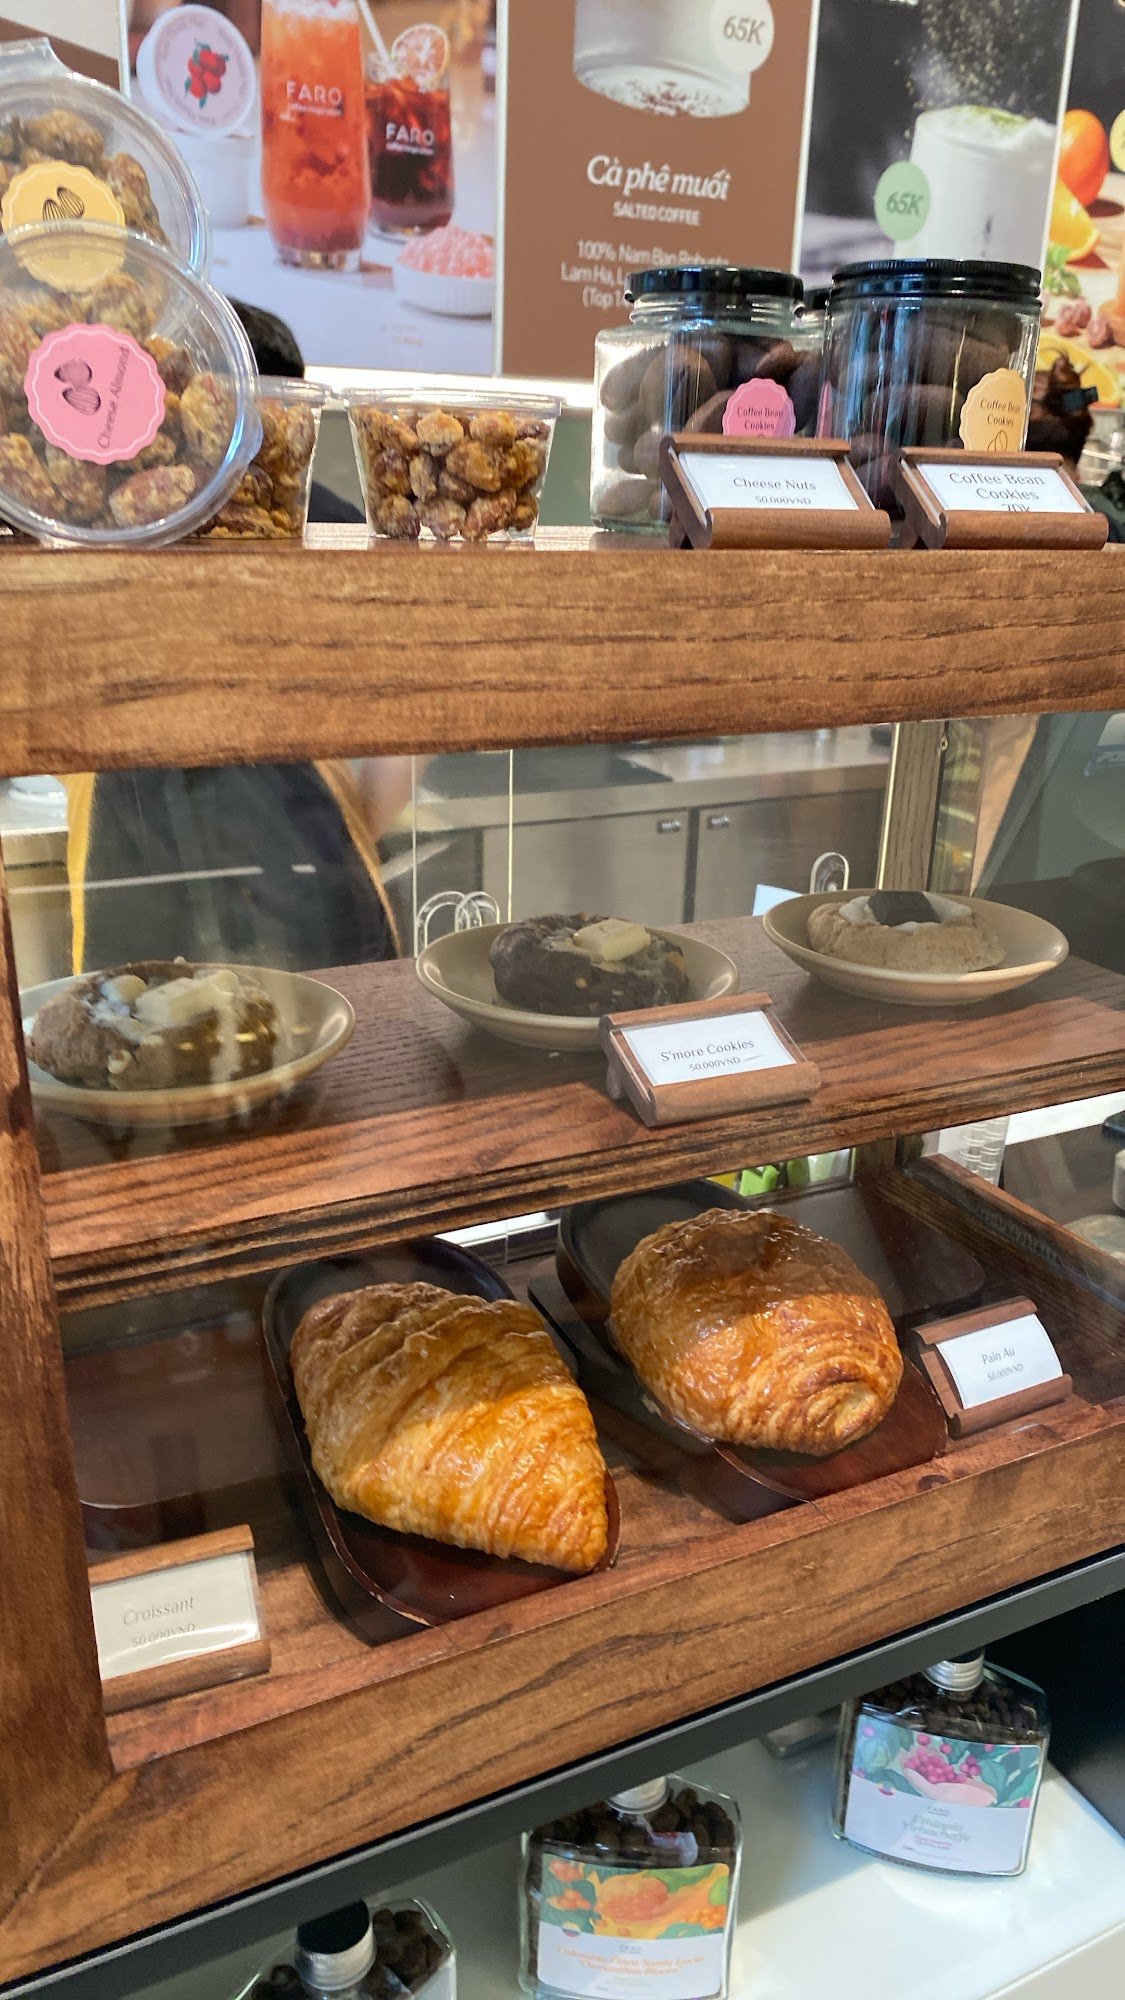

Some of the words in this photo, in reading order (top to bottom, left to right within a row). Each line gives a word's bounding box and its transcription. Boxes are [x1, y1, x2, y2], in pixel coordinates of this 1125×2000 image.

[723, 16, 765, 44] 65K
[287, 80, 342, 106] FARO
[386, 122, 434, 146] FARO
[587, 154, 623, 187] Cà
[623, 160, 671, 196] phê
[671, 168, 731, 200] muối
[613, 201, 657, 221] SALTED
[658, 206, 701, 226] COFFEE
[886, 192, 924, 216] 65K
[577, 240, 617, 262] 100%
[619, 243, 651, 265] Nam
[98, 400, 118, 449] Cheese
[110, 346, 130, 399] Almond
[981, 399, 1007, 411] Coffee
[737, 406, 763, 418] Coffee
[765, 407, 785, 418] Bean
[744, 421, 775, 431] Cookies
[733, 476, 782, 490] Cheese
[785, 479, 817, 491] Nuts
[949, 472, 1001, 486] Coffee
[1004, 473, 1045, 486] Bean
[755, 495, 812, 506] 50.000VND
[976, 487, 1039, 501] Cookies
[660, 1049, 704, 1063] S'more
[706, 1039, 755, 1056] Cookies
[689, 1056, 741, 1072] 50.000VND
[981, 1351, 1002, 1366] Pain
[1003, 1347, 1016, 1359] Au
[123, 1596, 195, 1626] Croissant
